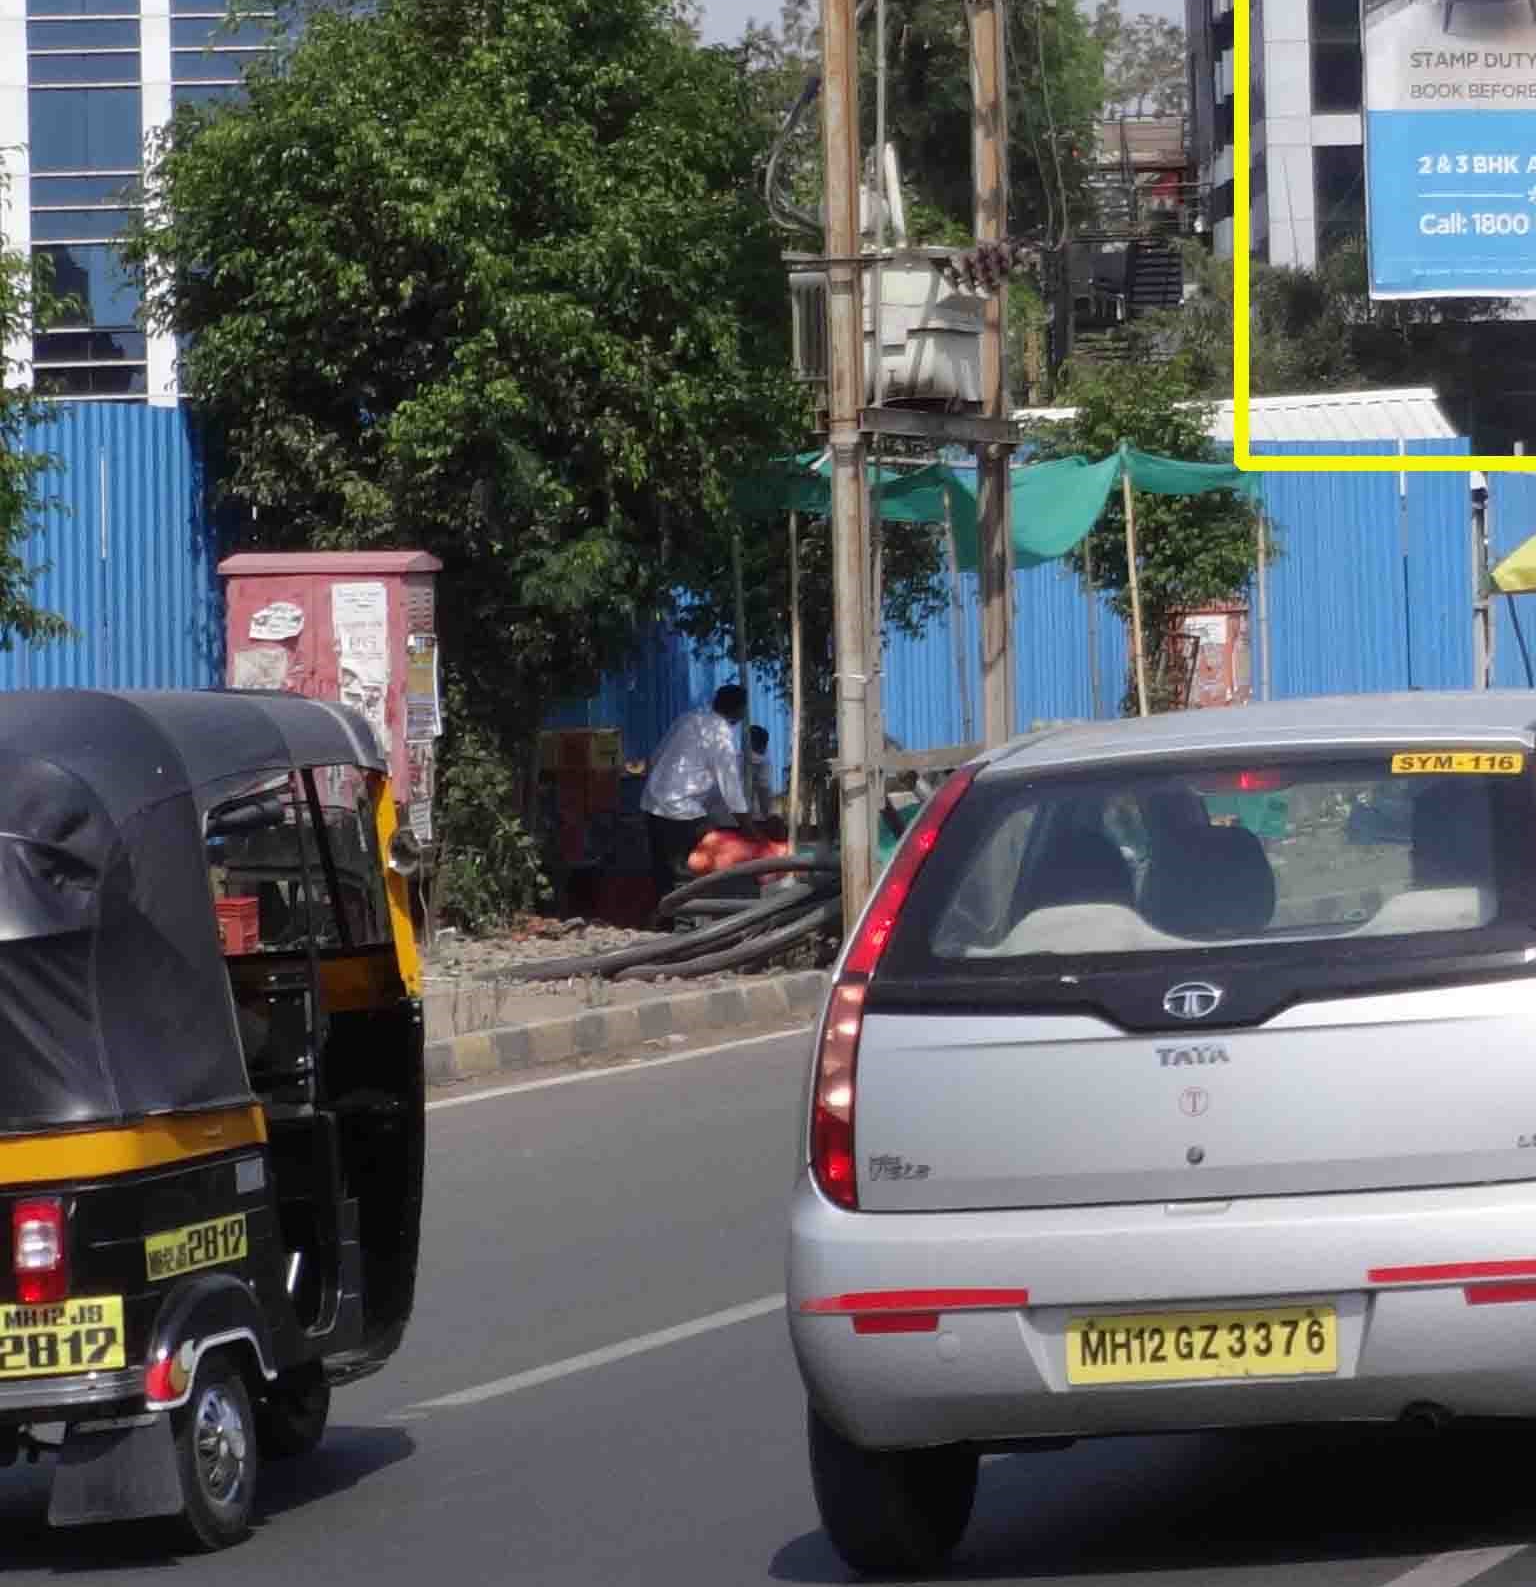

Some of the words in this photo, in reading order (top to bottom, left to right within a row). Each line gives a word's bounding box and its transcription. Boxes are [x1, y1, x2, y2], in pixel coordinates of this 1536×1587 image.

[1409, 51, 1479, 69] STAMP
[1410, 82, 1464, 99] BOOK
[1417, 155, 1433, 174] 2
[1436, 155, 1452, 174] &
[1455, 155, 1469, 174] 3
[1472, 155, 1520, 174] BHK
[1418, 213, 1468, 235] Call:
[1471, 212, 1529, 235] 1800
[1399, 755, 1515, 771] SYM-116
[1155, 1045, 1231, 1067] TATA
[1080, 1324, 1168, 1367] MH12
[1173, 1323, 1220, 1361] GZ
[1227, 1318, 1326, 1359] 3376
